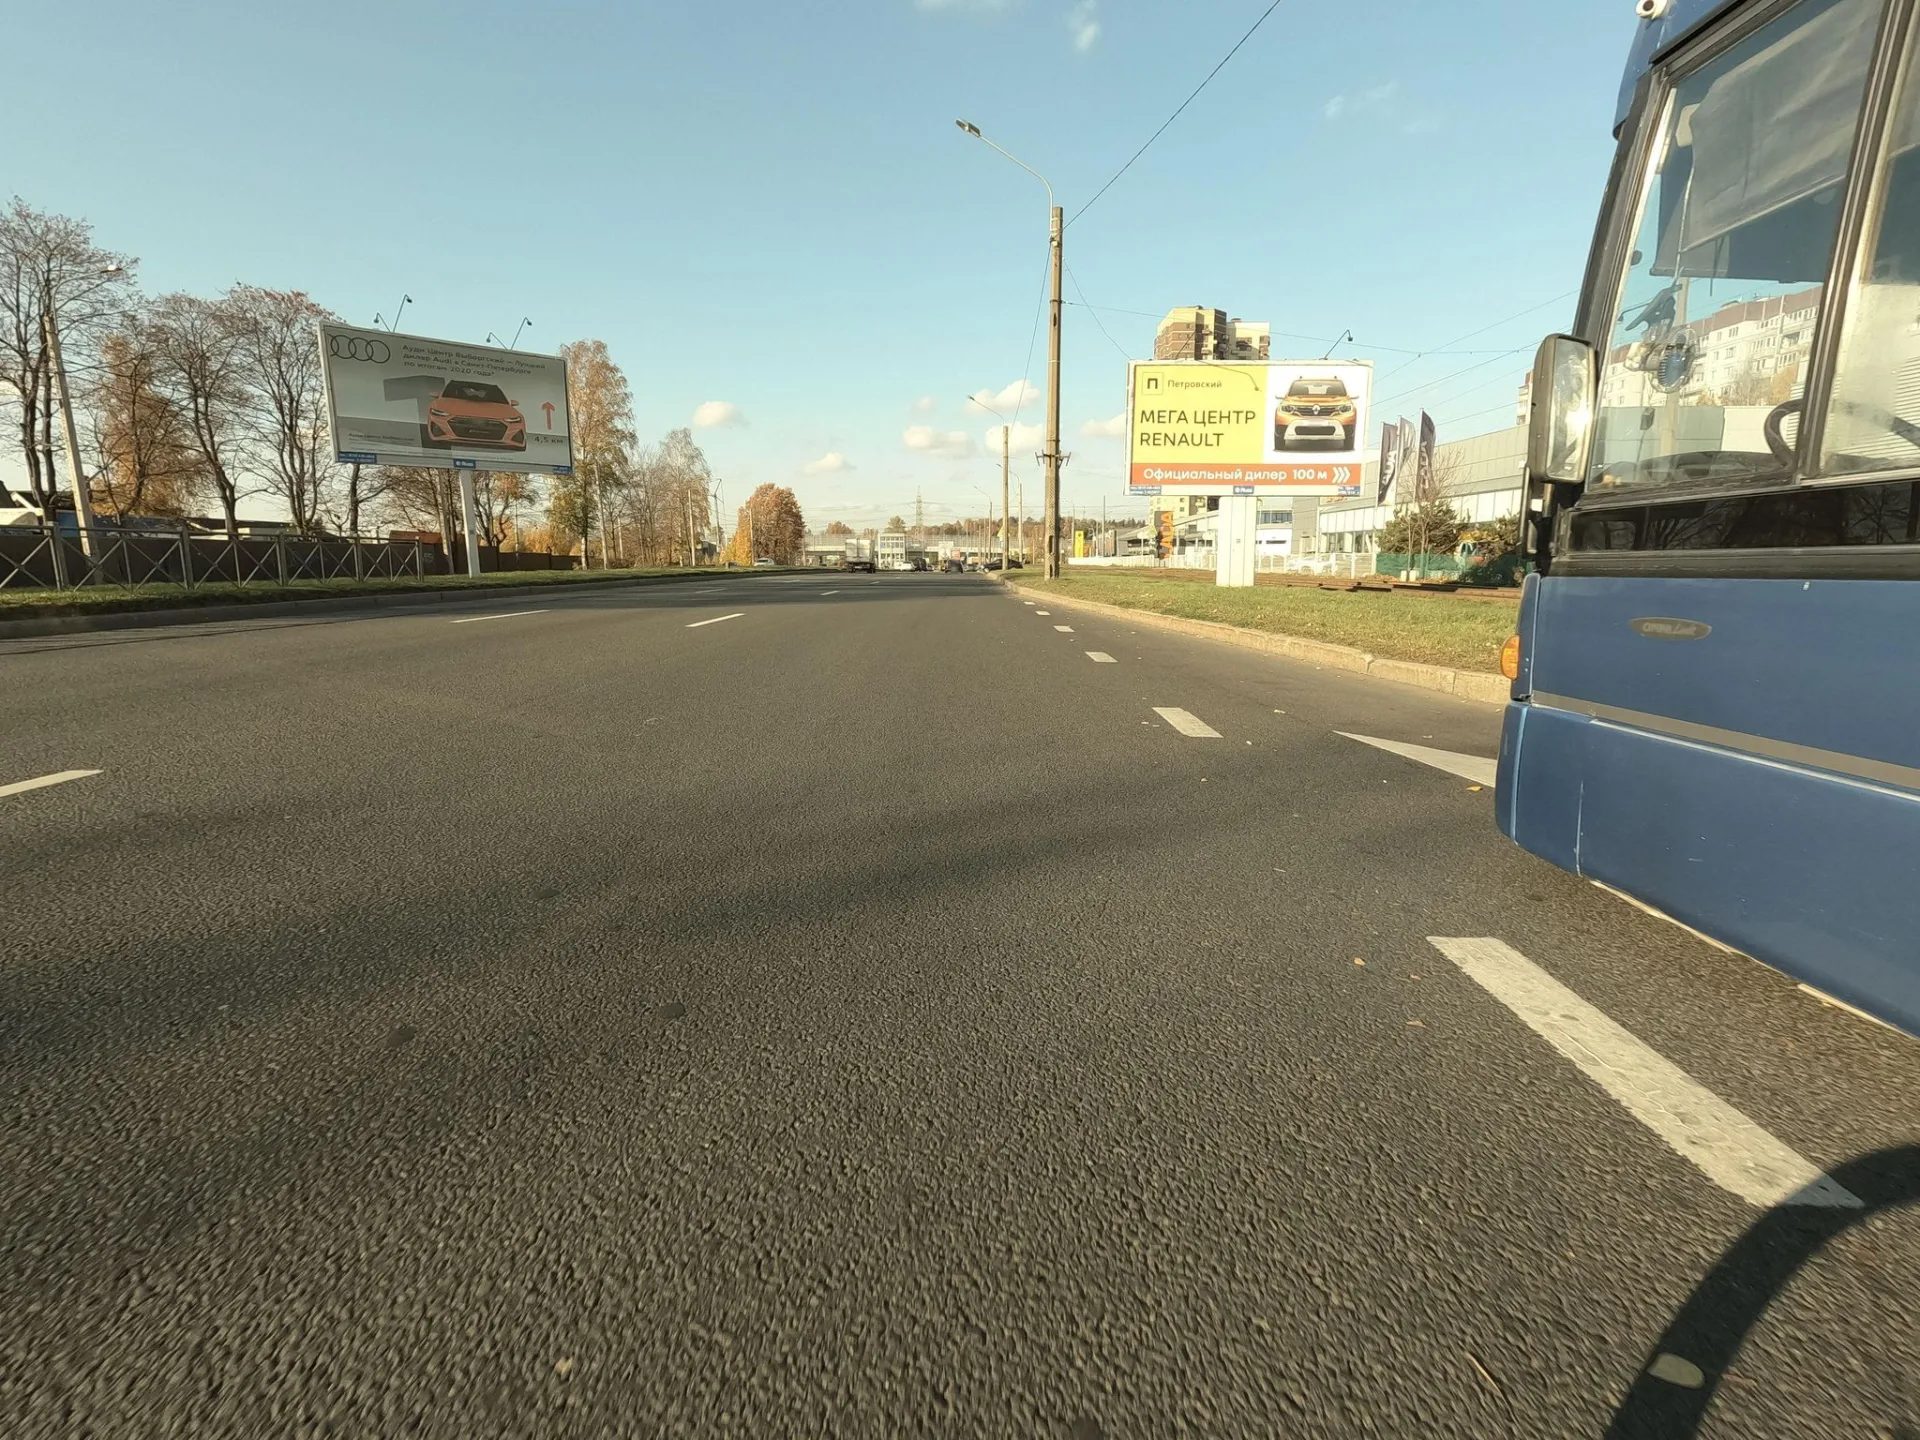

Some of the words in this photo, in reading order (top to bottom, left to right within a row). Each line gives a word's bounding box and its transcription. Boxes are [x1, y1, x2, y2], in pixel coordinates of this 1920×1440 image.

[432, 356, 452, 364] Audi
[450, 366, 471, 374] 2020
[1167, 379, 1222, 390] Петровский
[1140, 410, 1188, 424] МЕГА
[1194, 410, 1256, 427] ЦЕНТР
[1140, 433, 1224, 447] RENAULT
[1143, 466, 1242, 482] Официальный
[1245, 470, 1287, 481] дилер
[1293, 469, 1315, 480] 100
[1317, 472, 1327, 480] м
